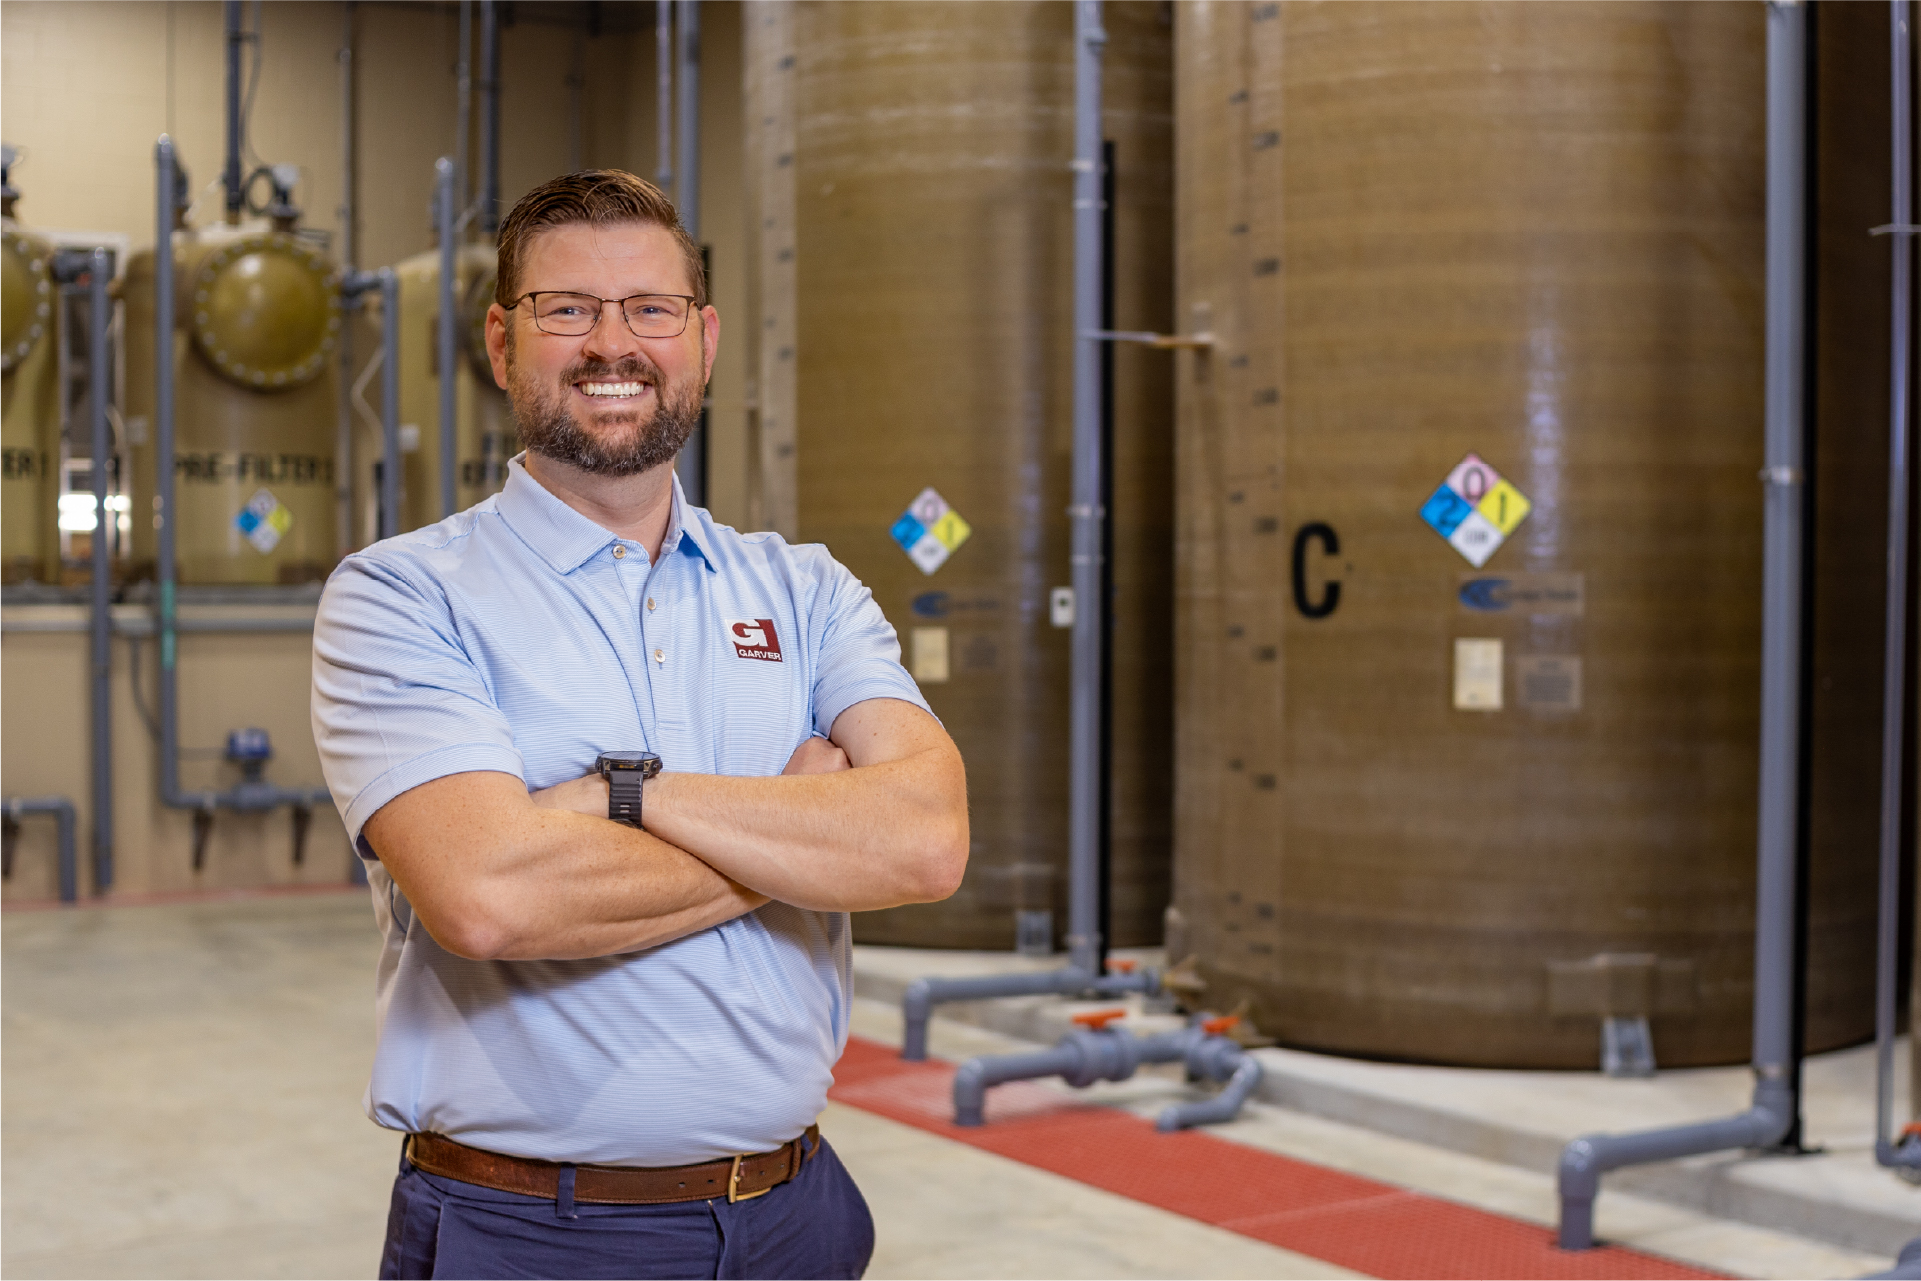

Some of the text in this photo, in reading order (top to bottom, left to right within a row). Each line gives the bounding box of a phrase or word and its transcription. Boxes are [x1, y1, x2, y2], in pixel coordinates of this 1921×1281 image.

[1463, 466, 1485, 501] 0
[1438, 494, 1459, 528] 2
[1499, 491, 1507, 524] 1
[1292, 522, 1340, 619] C
[738, 648, 782, 661] GARVER
